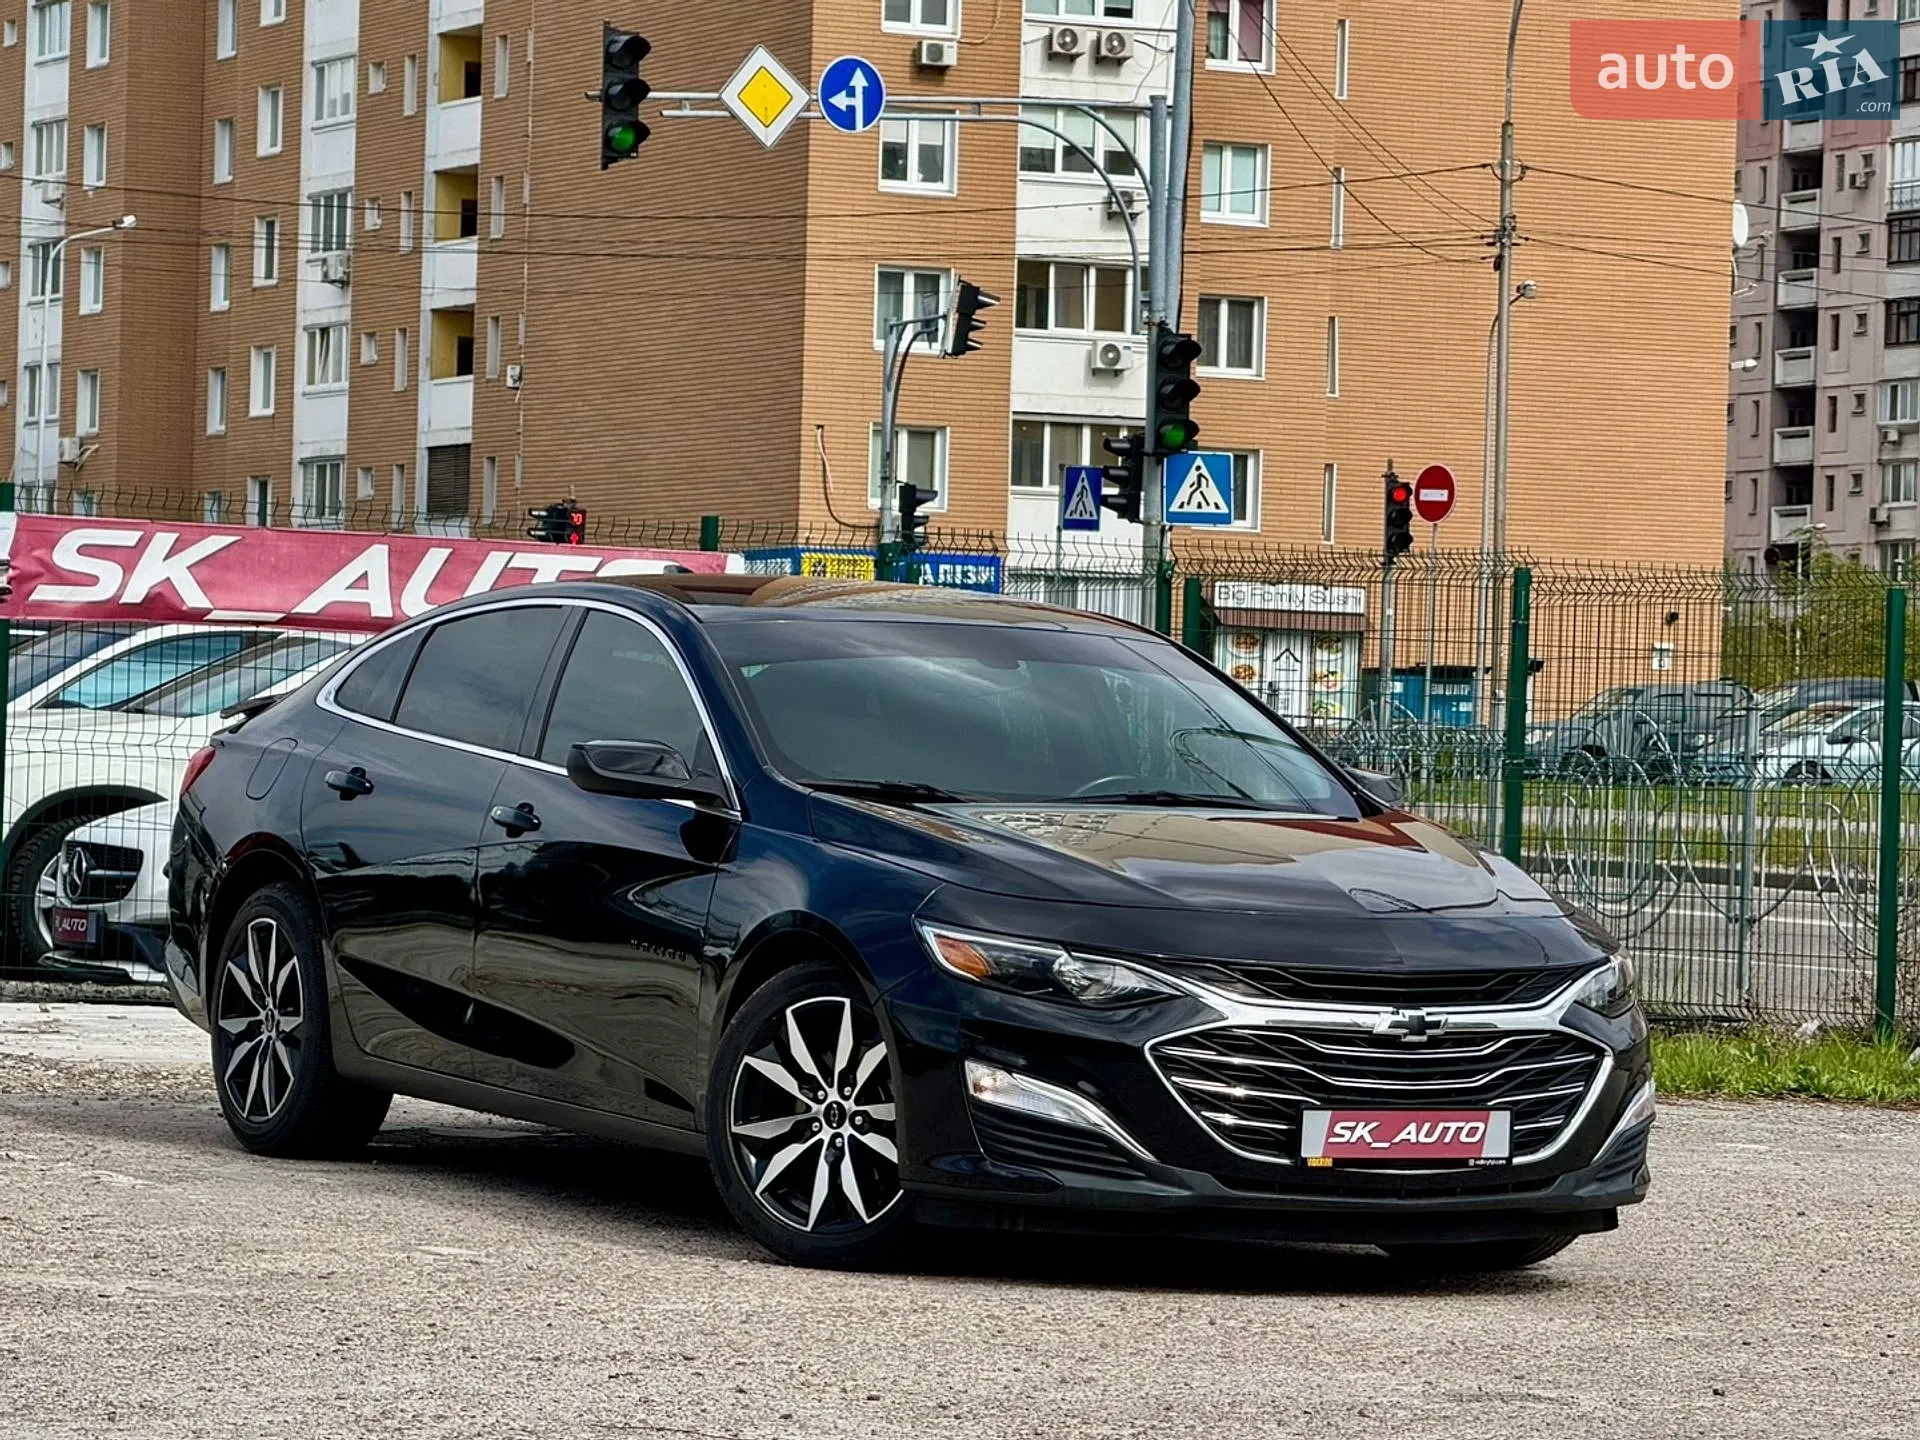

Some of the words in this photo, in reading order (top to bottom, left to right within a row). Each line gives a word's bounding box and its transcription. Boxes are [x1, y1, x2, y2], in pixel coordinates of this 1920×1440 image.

[27, 527, 684, 625] SK_AUT
[1218, 584, 1246, 605] Big
[1327, 1120, 1487, 1149] SK_AUTO
